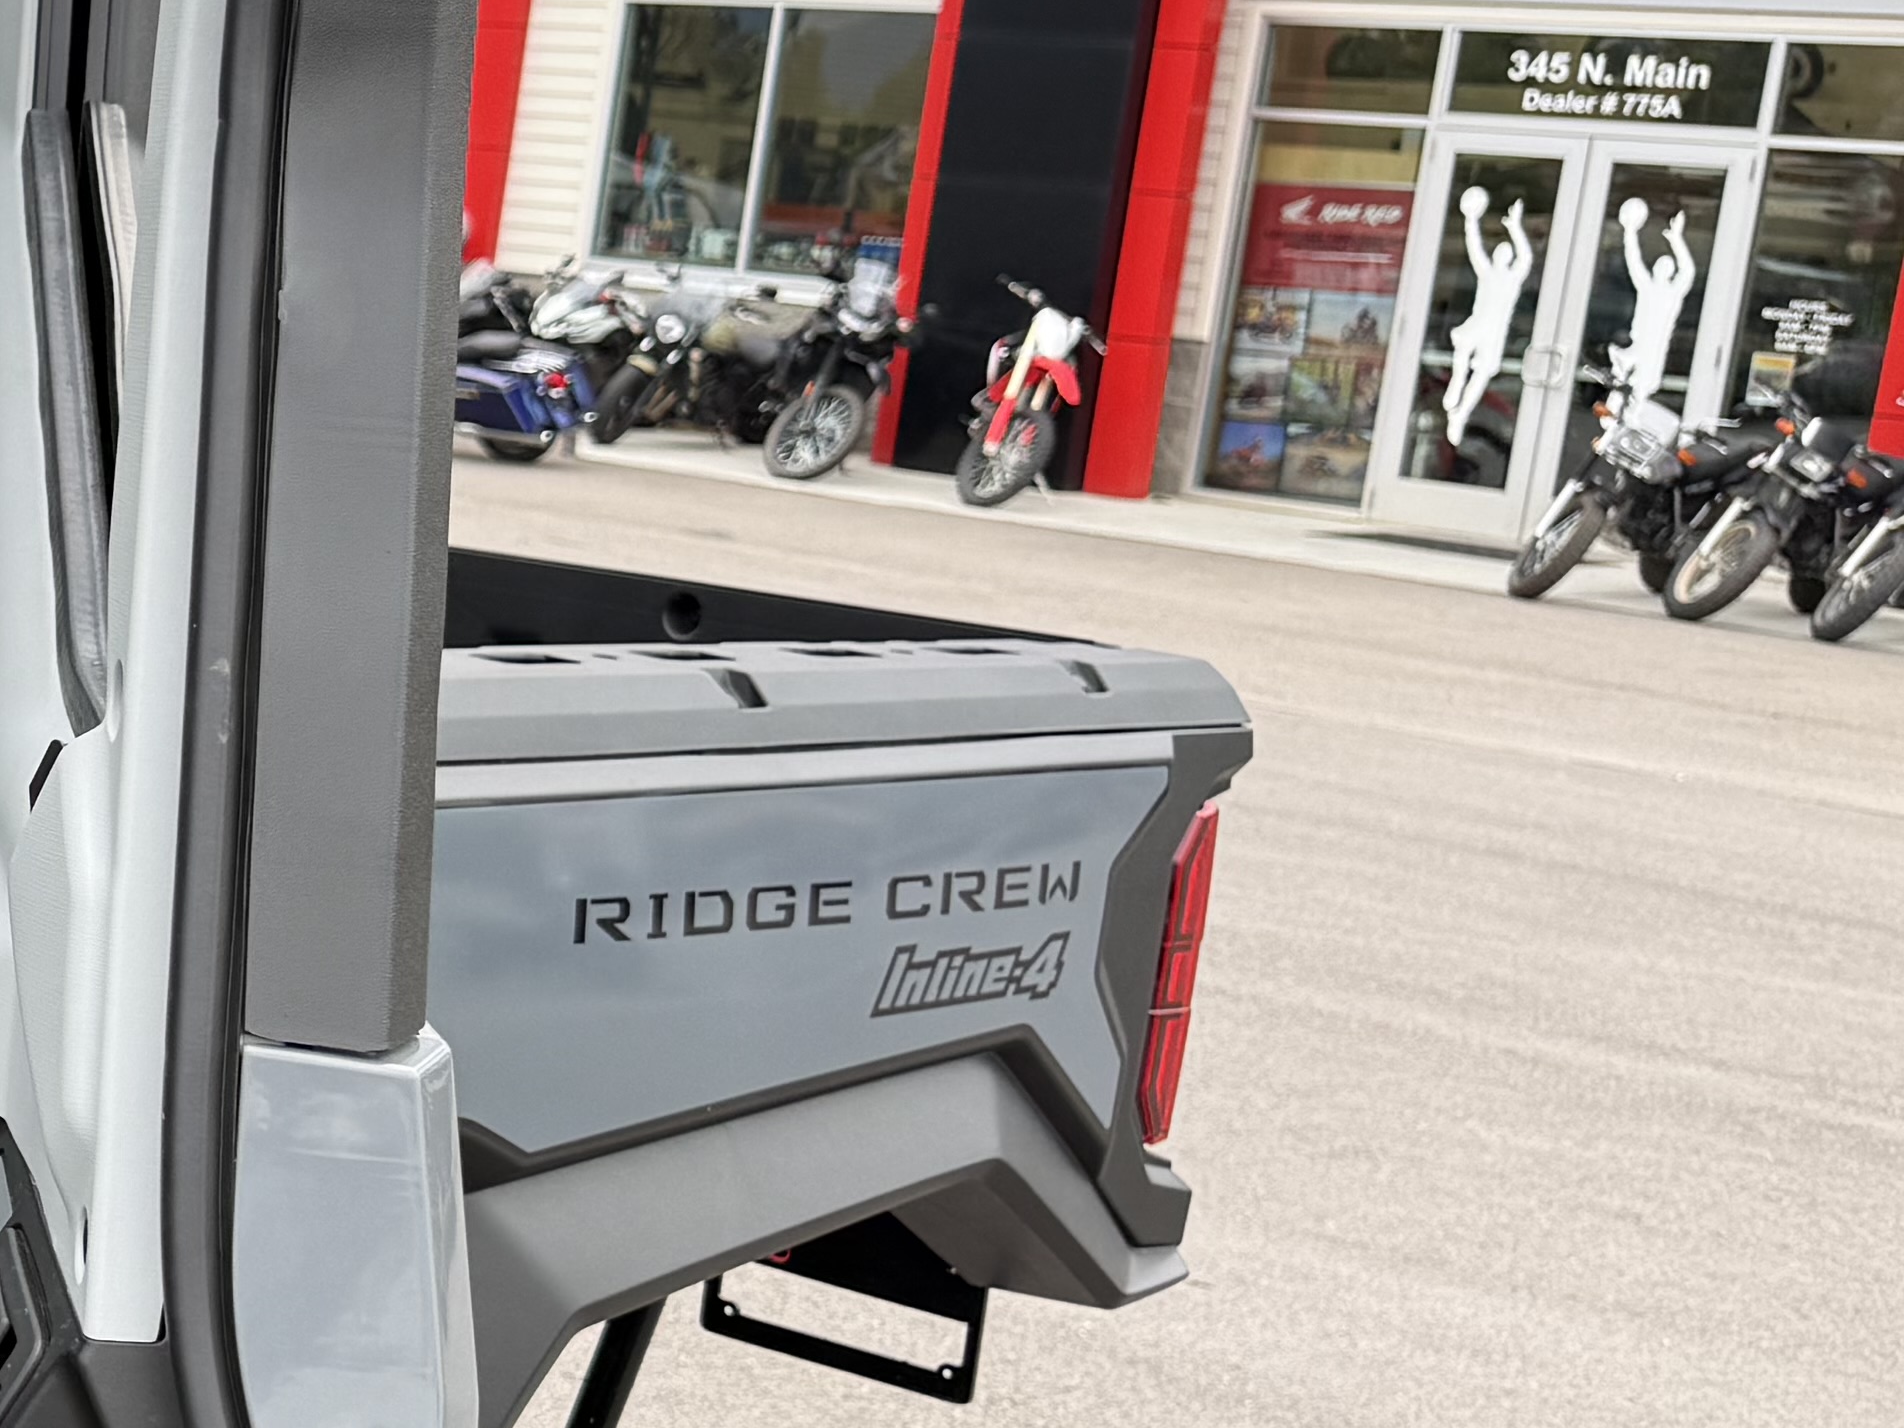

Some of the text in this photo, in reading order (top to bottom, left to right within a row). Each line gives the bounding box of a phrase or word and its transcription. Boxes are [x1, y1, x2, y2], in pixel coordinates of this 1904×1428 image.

[1507, 49, 1712, 90] 345 N. Main
[1521, 87, 1599, 114] Dealer
[1622, 93, 1683, 119] 775A
[573, 860, 1081, 944] RIDGE CREW
[870, 931, 1071, 1018] Inline-4
